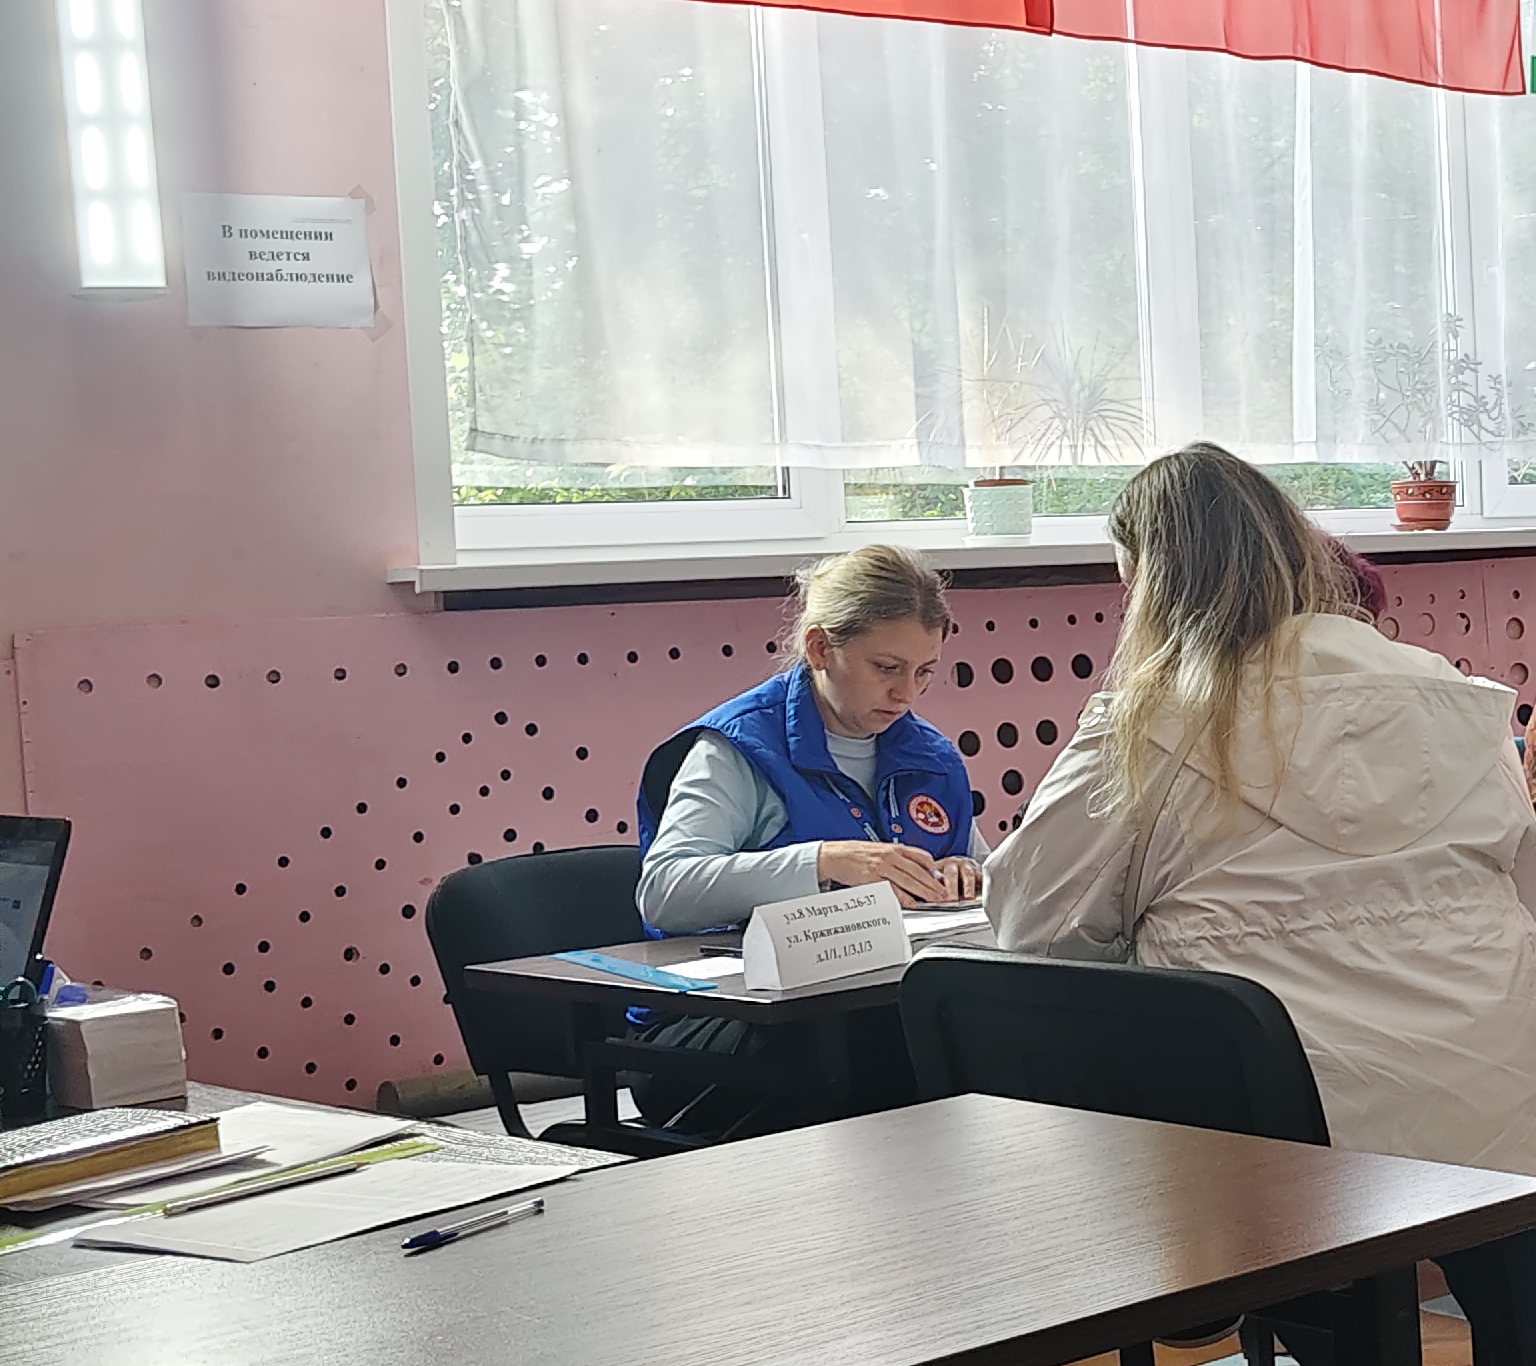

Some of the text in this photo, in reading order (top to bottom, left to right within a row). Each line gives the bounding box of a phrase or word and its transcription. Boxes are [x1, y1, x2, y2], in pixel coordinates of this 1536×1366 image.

[221, 224, 333, 241] В помещении
[248, 250, 311, 262] ведется
[206, 269, 354, 284] видеонаблюдение
